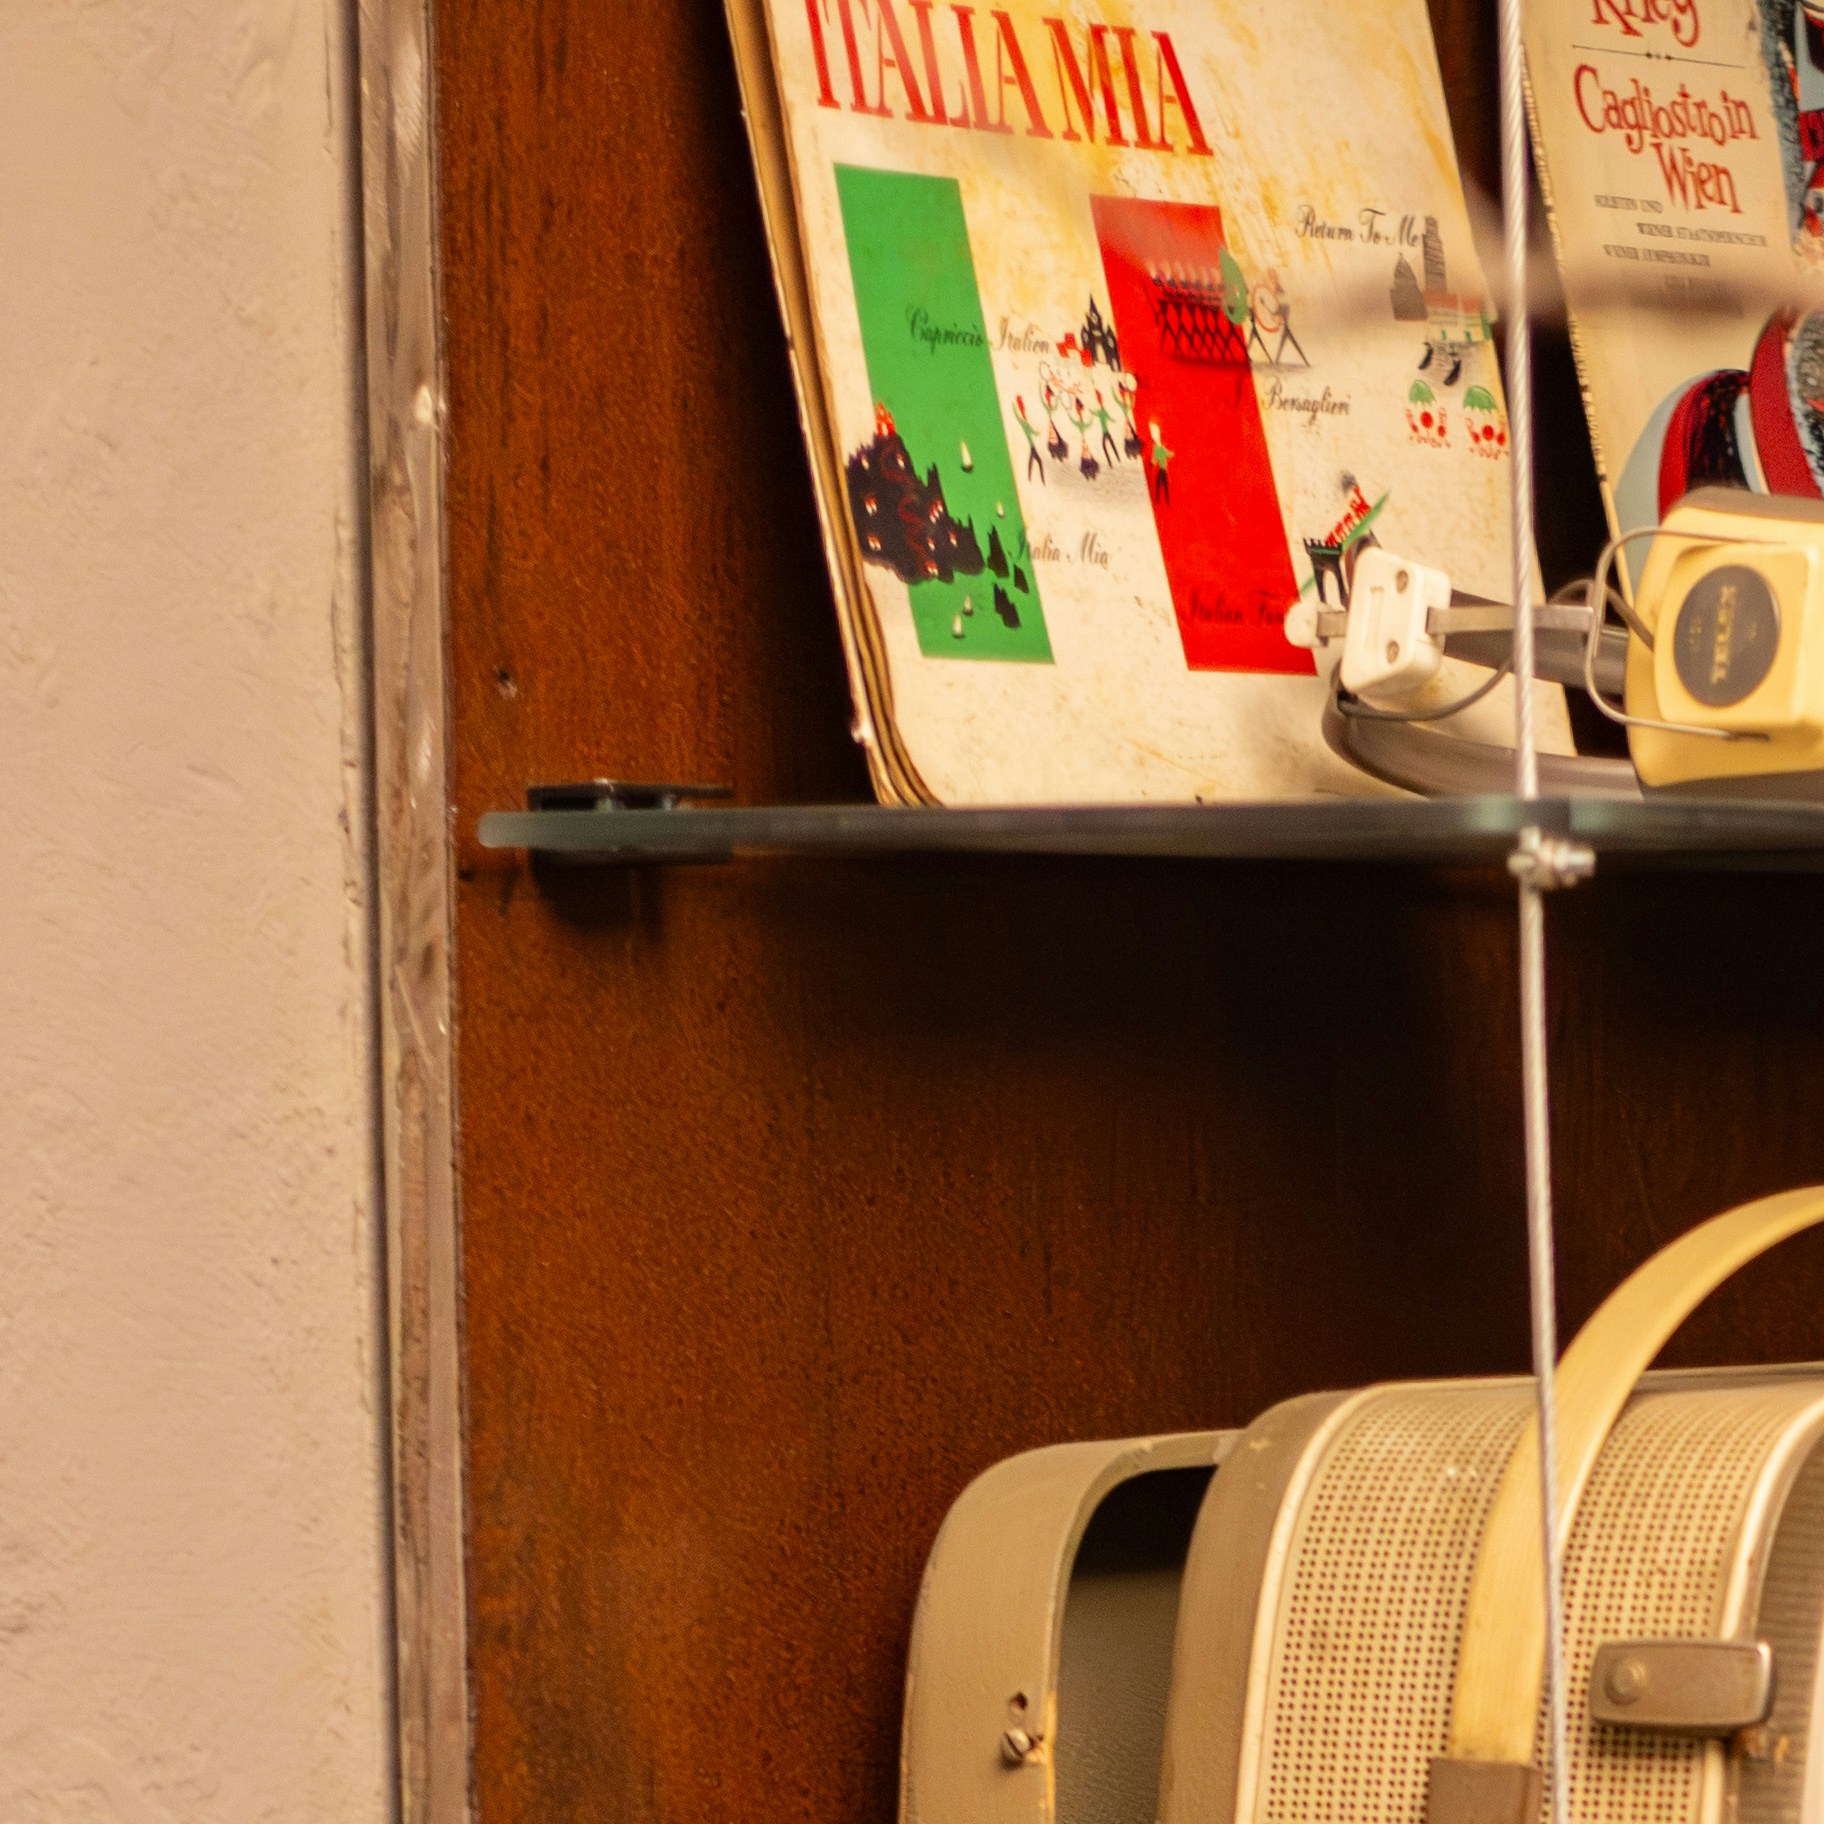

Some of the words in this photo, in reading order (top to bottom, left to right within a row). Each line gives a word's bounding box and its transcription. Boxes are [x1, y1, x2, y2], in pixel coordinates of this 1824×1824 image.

[804, 0, 1054, 140] ITALIA
[1042, 16, 1214, 157] MIA
[1573, 63, 1727, 155] Cagliostro
[1719, 90, 1760, 141] in
[1650, 142, 1745, 214] Wien
[1294, 204, 1353, 242] Return
[1359, 207, 1386, 246] To
[1385, 213, 1420, 248] Me
[905, 303, 984, 357] Capriccio
[1258, 374, 1352, 427] Bersaglieri
[1066, 530, 1110, 570] Mia
